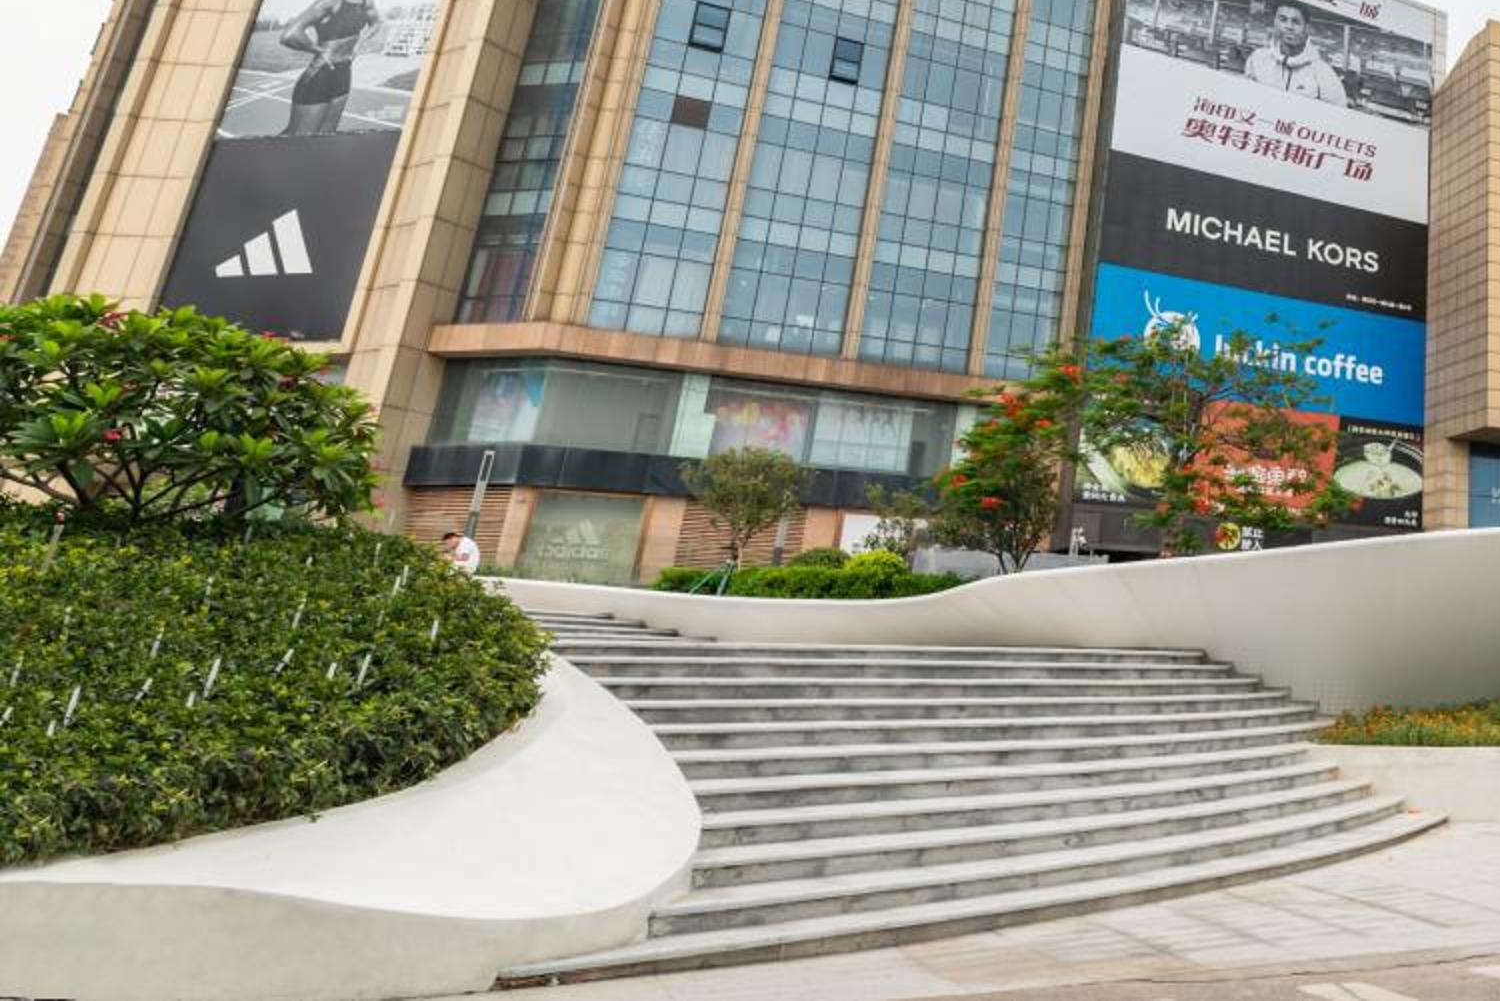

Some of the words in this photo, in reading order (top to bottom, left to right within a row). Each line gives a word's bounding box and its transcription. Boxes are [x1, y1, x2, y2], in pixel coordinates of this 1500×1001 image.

[1181, 117, 1375, 183] 奥特莱斯广场
[1297, 125, 1377, 159] OUTLETS
[1165, 207, 1297, 258] MICHAEL
[1307, 237, 1381, 274] KORS
[1304, 352, 1384, 385] coffee
